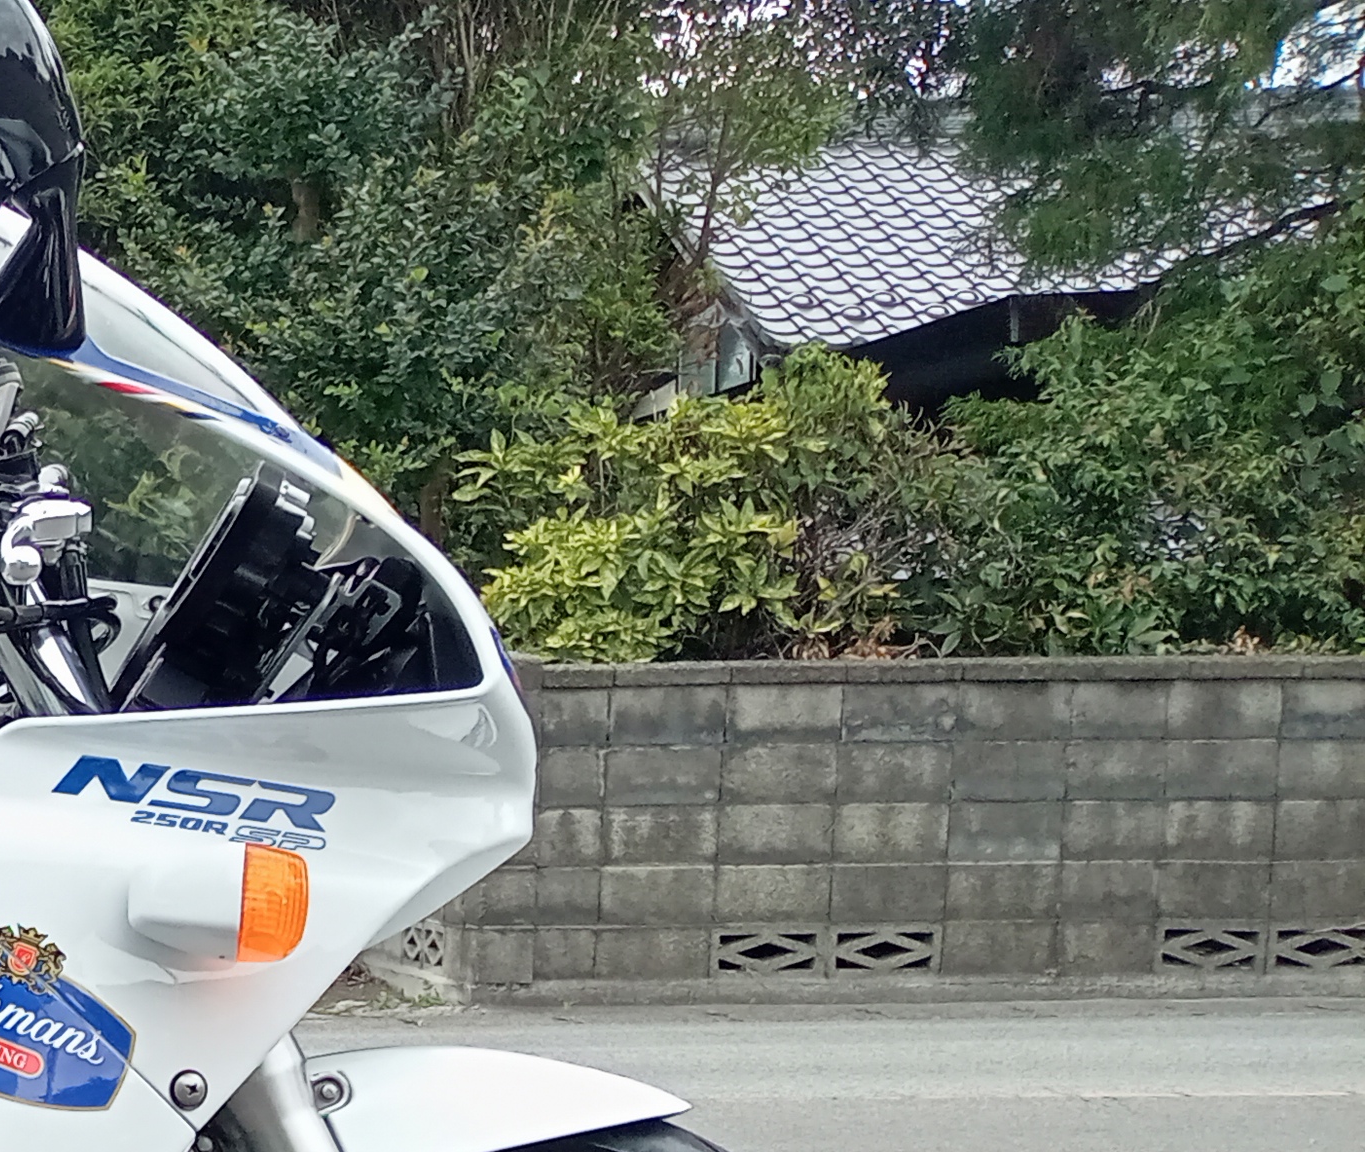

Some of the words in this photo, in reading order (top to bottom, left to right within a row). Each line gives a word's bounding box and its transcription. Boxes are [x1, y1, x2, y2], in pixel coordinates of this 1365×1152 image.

[51, 754, 336, 833] NSR
[130, 810, 229, 835] 250R
[228, 825, 326, 850] SP
